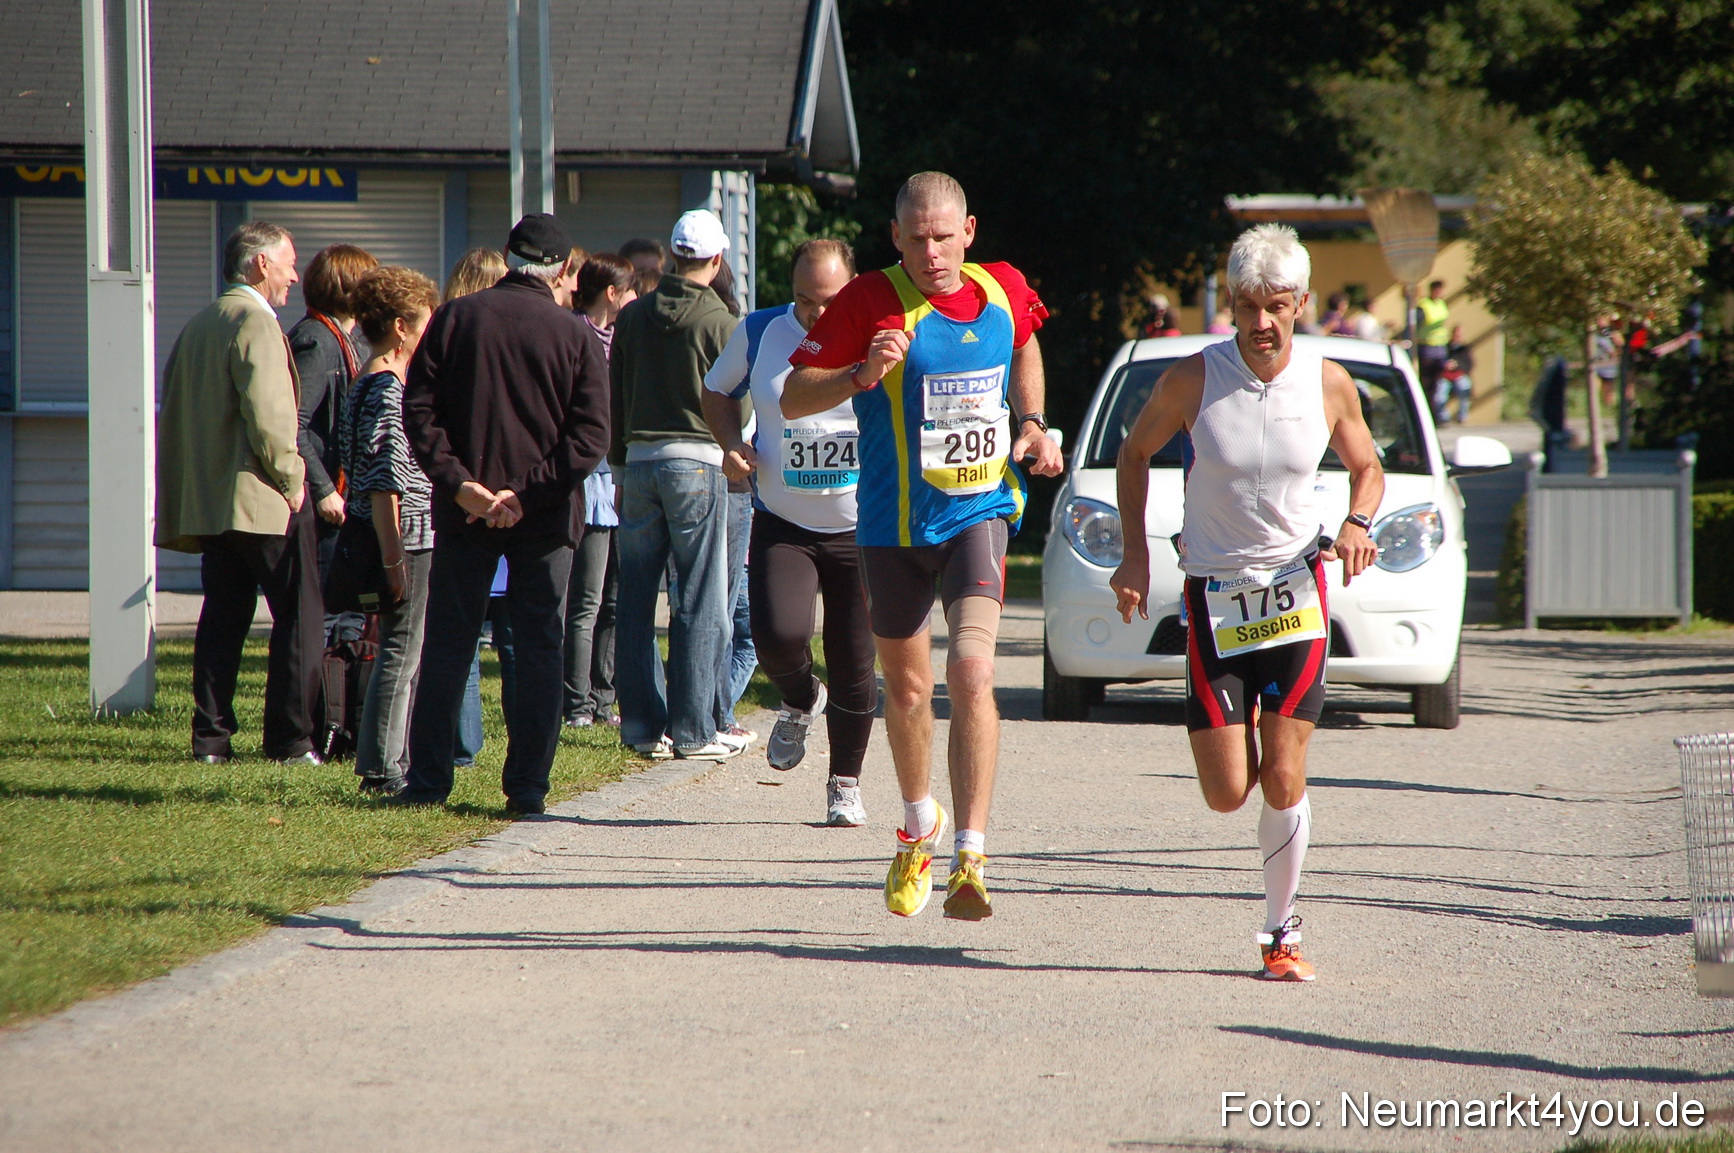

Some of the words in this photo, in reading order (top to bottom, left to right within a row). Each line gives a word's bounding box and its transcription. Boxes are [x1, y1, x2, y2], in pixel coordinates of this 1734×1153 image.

[933, 381, 966, 394] LIFE
[969, 376, 997, 392] PARK
[790, 441, 856, 469] 3124
[944, 427, 996, 465] 298
[797, 471, 849, 486] Ioannis
[957, 463, 988, 483] Ralf
[1231, 580, 1295, 622] 175
[1236, 615, 1302, 643] Sascha
